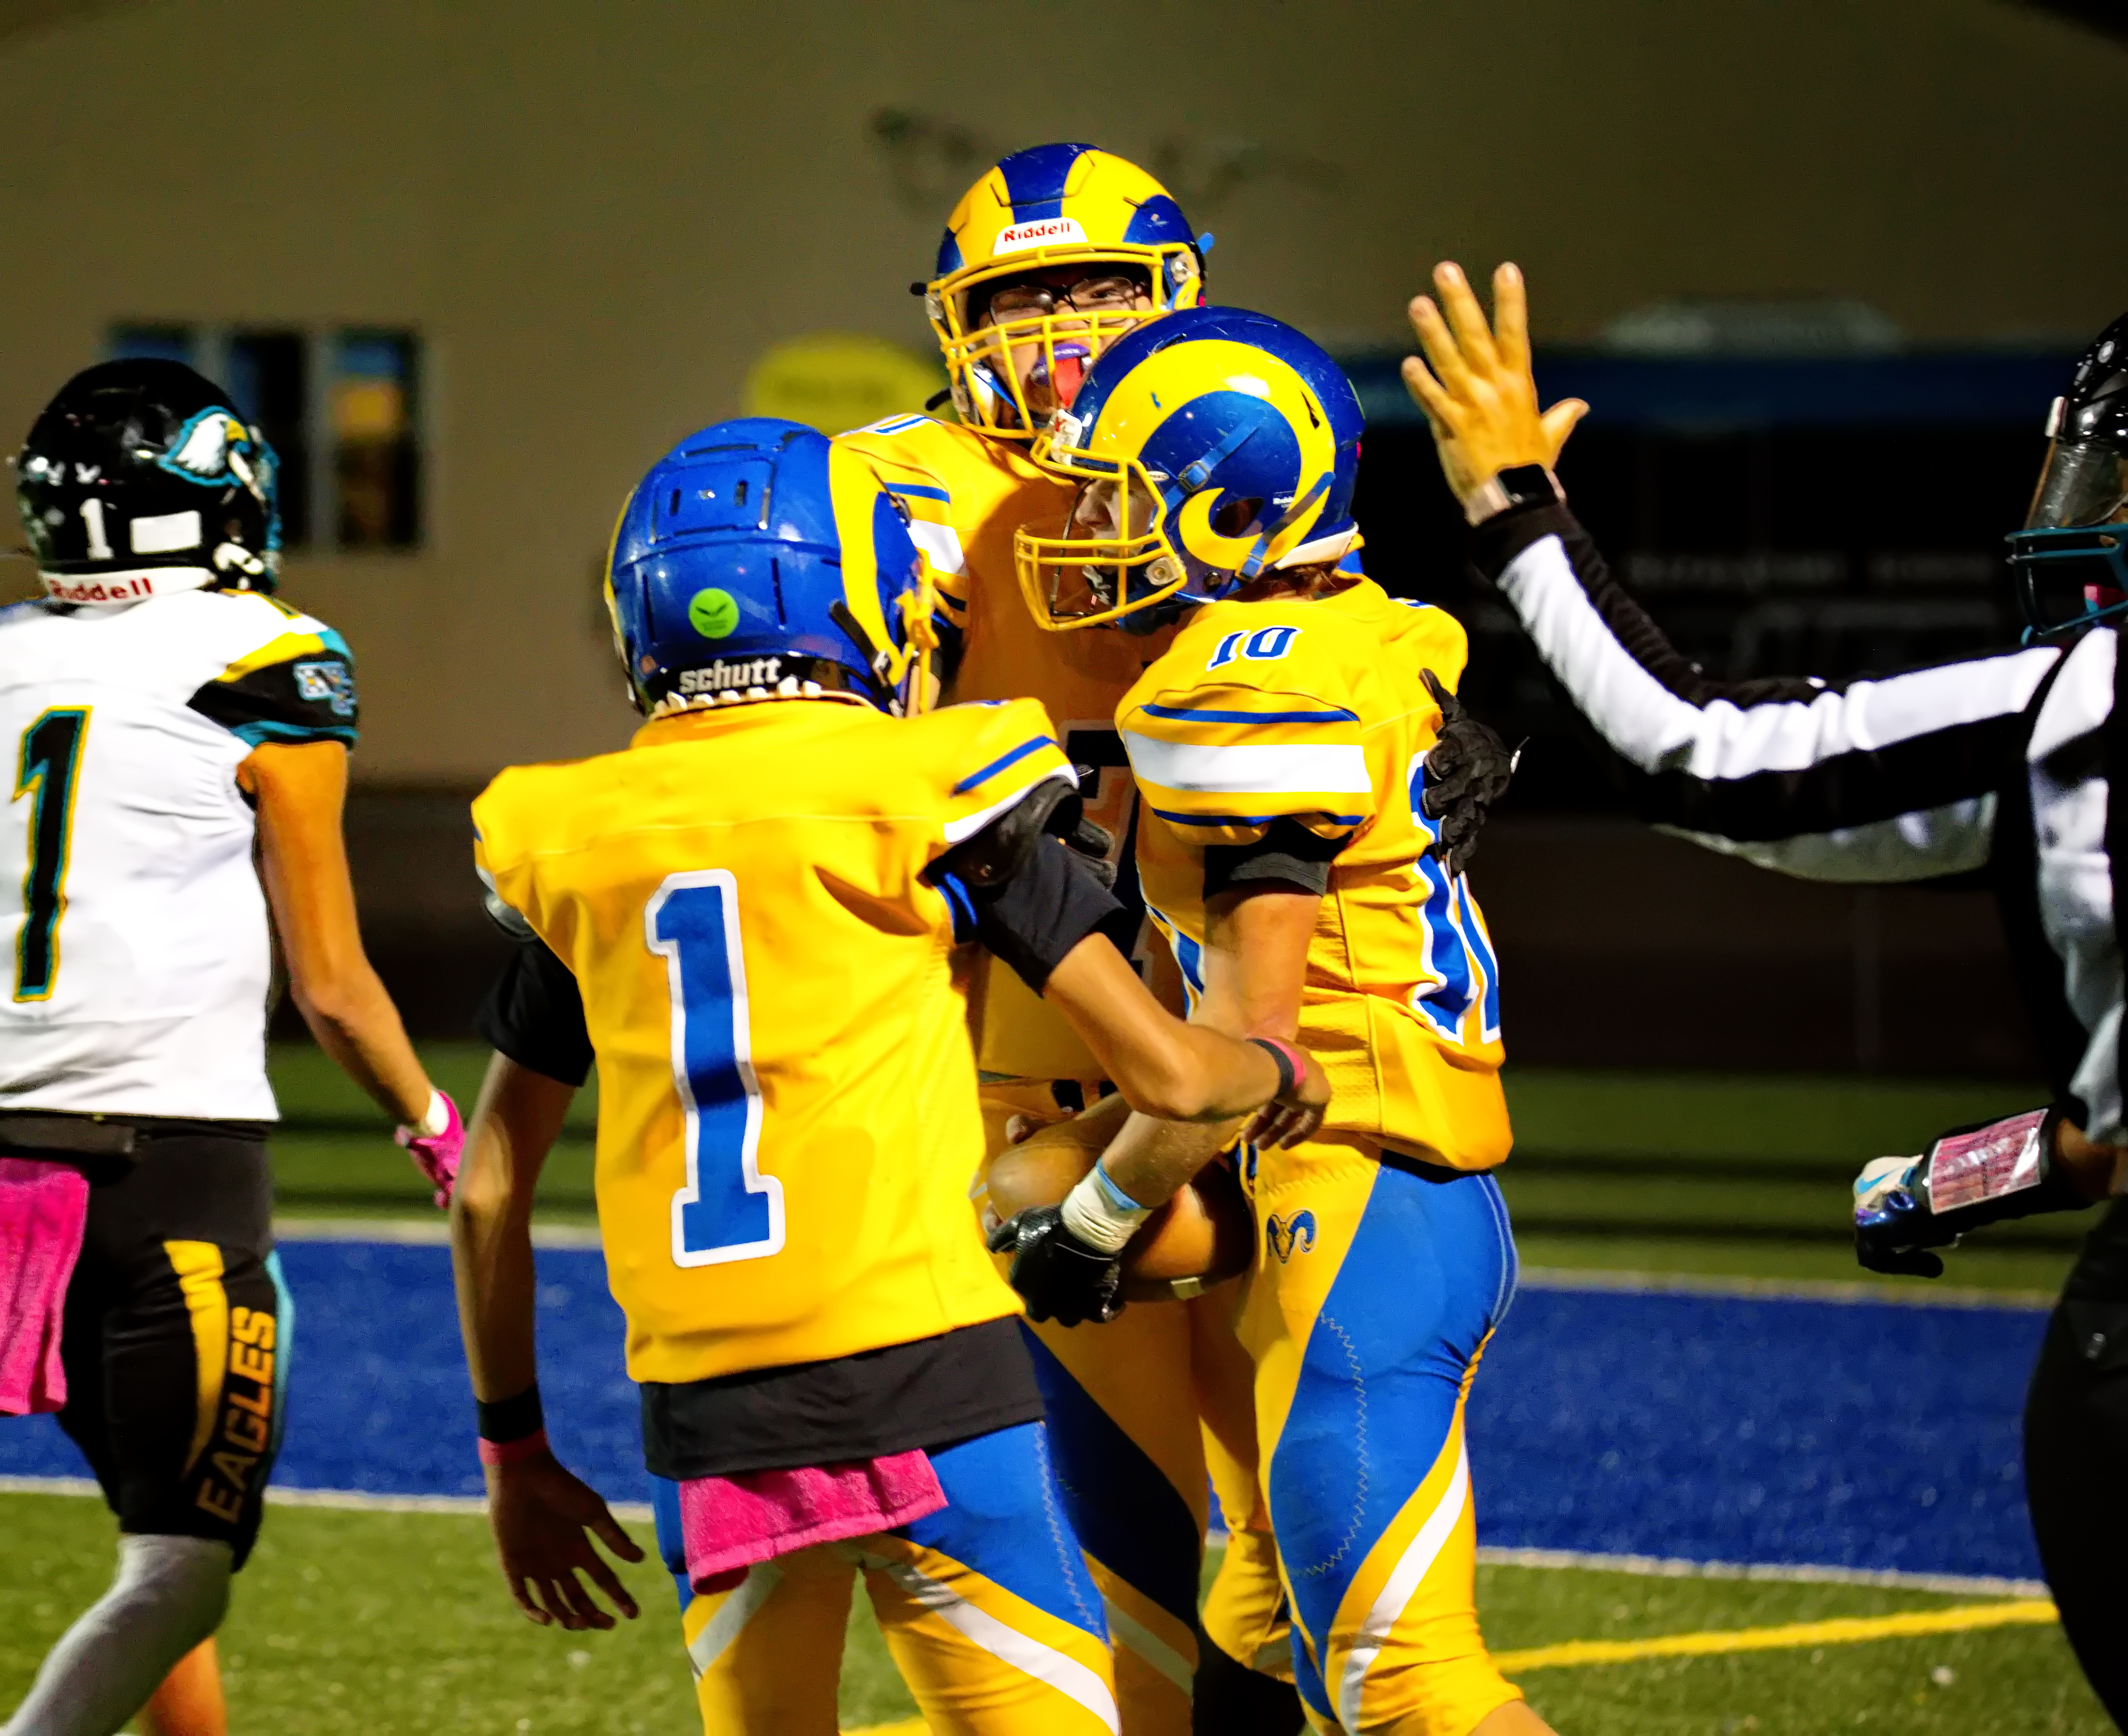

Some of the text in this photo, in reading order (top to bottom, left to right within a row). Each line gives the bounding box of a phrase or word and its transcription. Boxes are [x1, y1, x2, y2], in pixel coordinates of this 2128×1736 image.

[1004, 223, 1070, 242] Riddell
[79, 498, 115, 559] 1
[679, 657, 782, 694] schutt
[1205, 625, 1303, 672] 10
[10, 705, 93, 1003] 1
[645, 868, 786, 1268] 1
[195, 1306, 276, 1524] EAGLES
